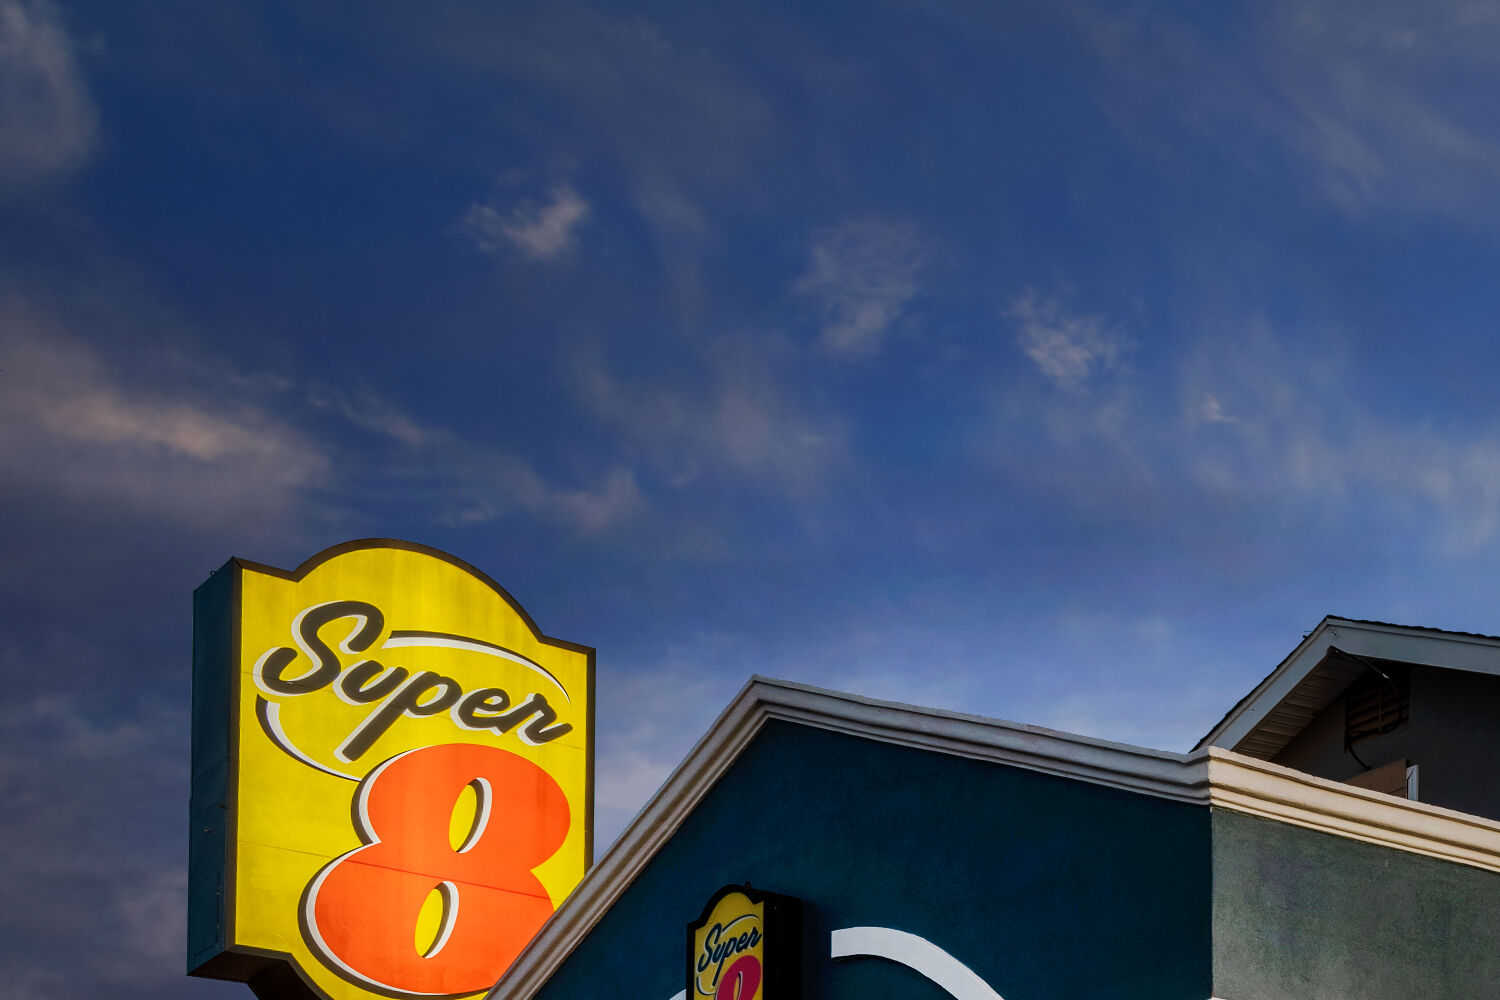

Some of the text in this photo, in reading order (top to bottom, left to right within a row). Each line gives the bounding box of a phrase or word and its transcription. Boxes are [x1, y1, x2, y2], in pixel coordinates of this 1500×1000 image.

[254, 600, 573, 763] Super
[298, 743, 571, 1000] 8
[696, 923, 762, 988] Super
